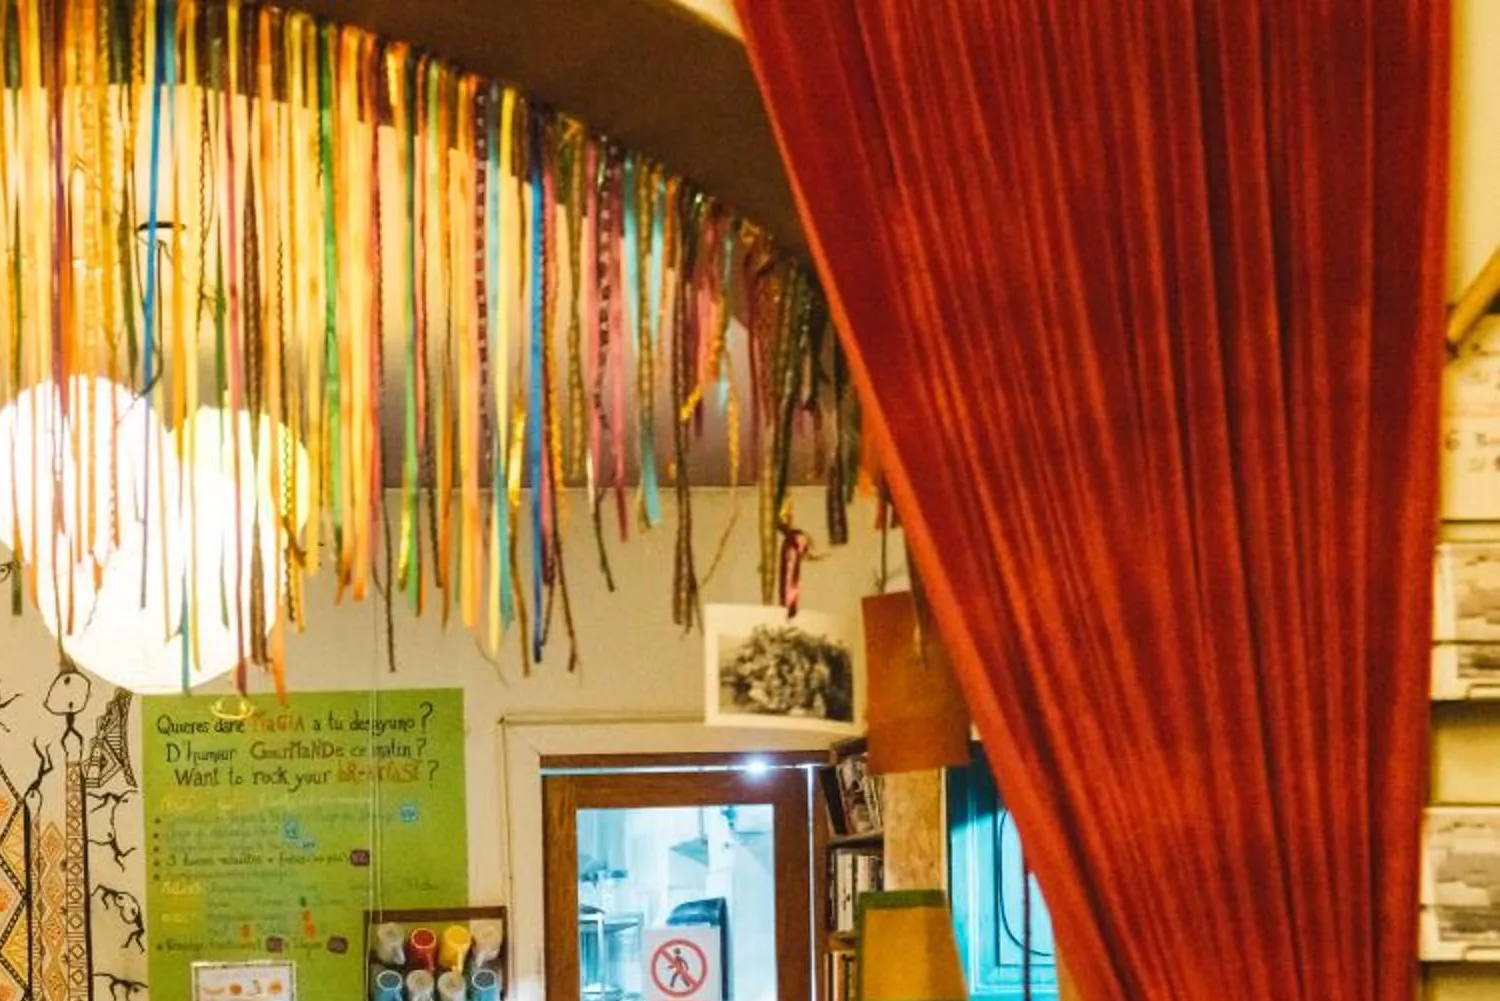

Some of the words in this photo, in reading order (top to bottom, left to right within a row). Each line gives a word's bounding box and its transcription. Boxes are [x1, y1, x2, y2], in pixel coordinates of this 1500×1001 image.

[327, 709, 343, 731] tu
[174, 767, 220, 787] Want
[228, 767, 244, 785] to
[287, 771, 332, 793] your
